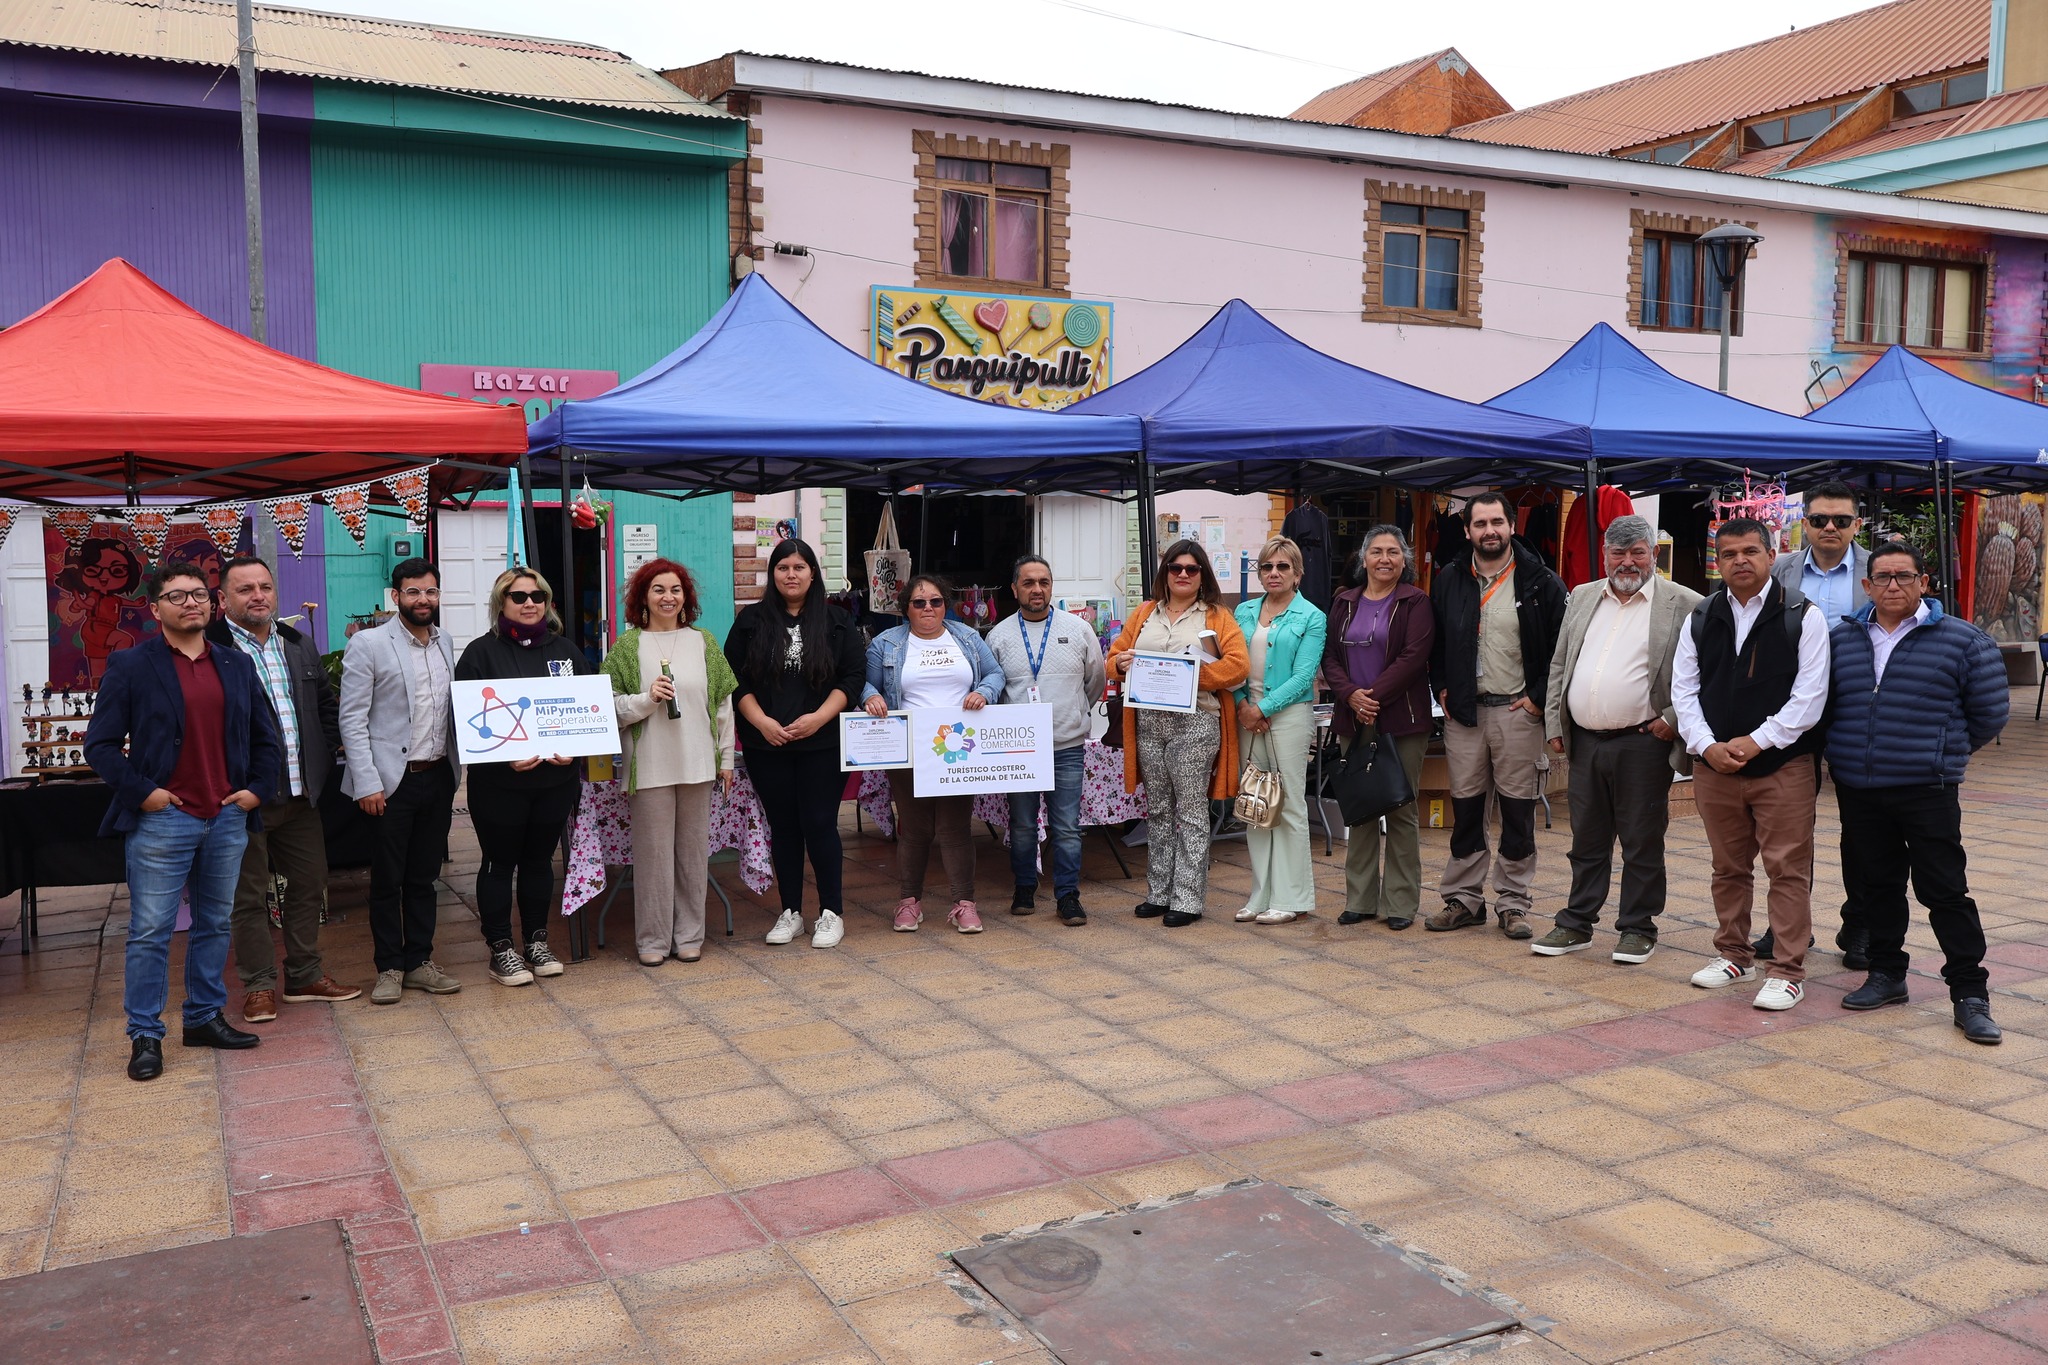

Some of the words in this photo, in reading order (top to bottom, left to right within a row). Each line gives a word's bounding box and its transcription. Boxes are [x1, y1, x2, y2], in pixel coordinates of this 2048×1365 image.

[897, 326, 1092, 396] Panguipulli
[473, 371, 570, 392] Bazar
[536, 706, 589, 717] MiPymes
[536, 715, 608, 727] Cooperativas
[980, 726, 1035, 740] BARRIOS
[980, 739, 1036, 749] COMERCIALES
[947, 765, 989, 774] TURÍSTICO
[991, 764, 1026, 772] COSTERO
